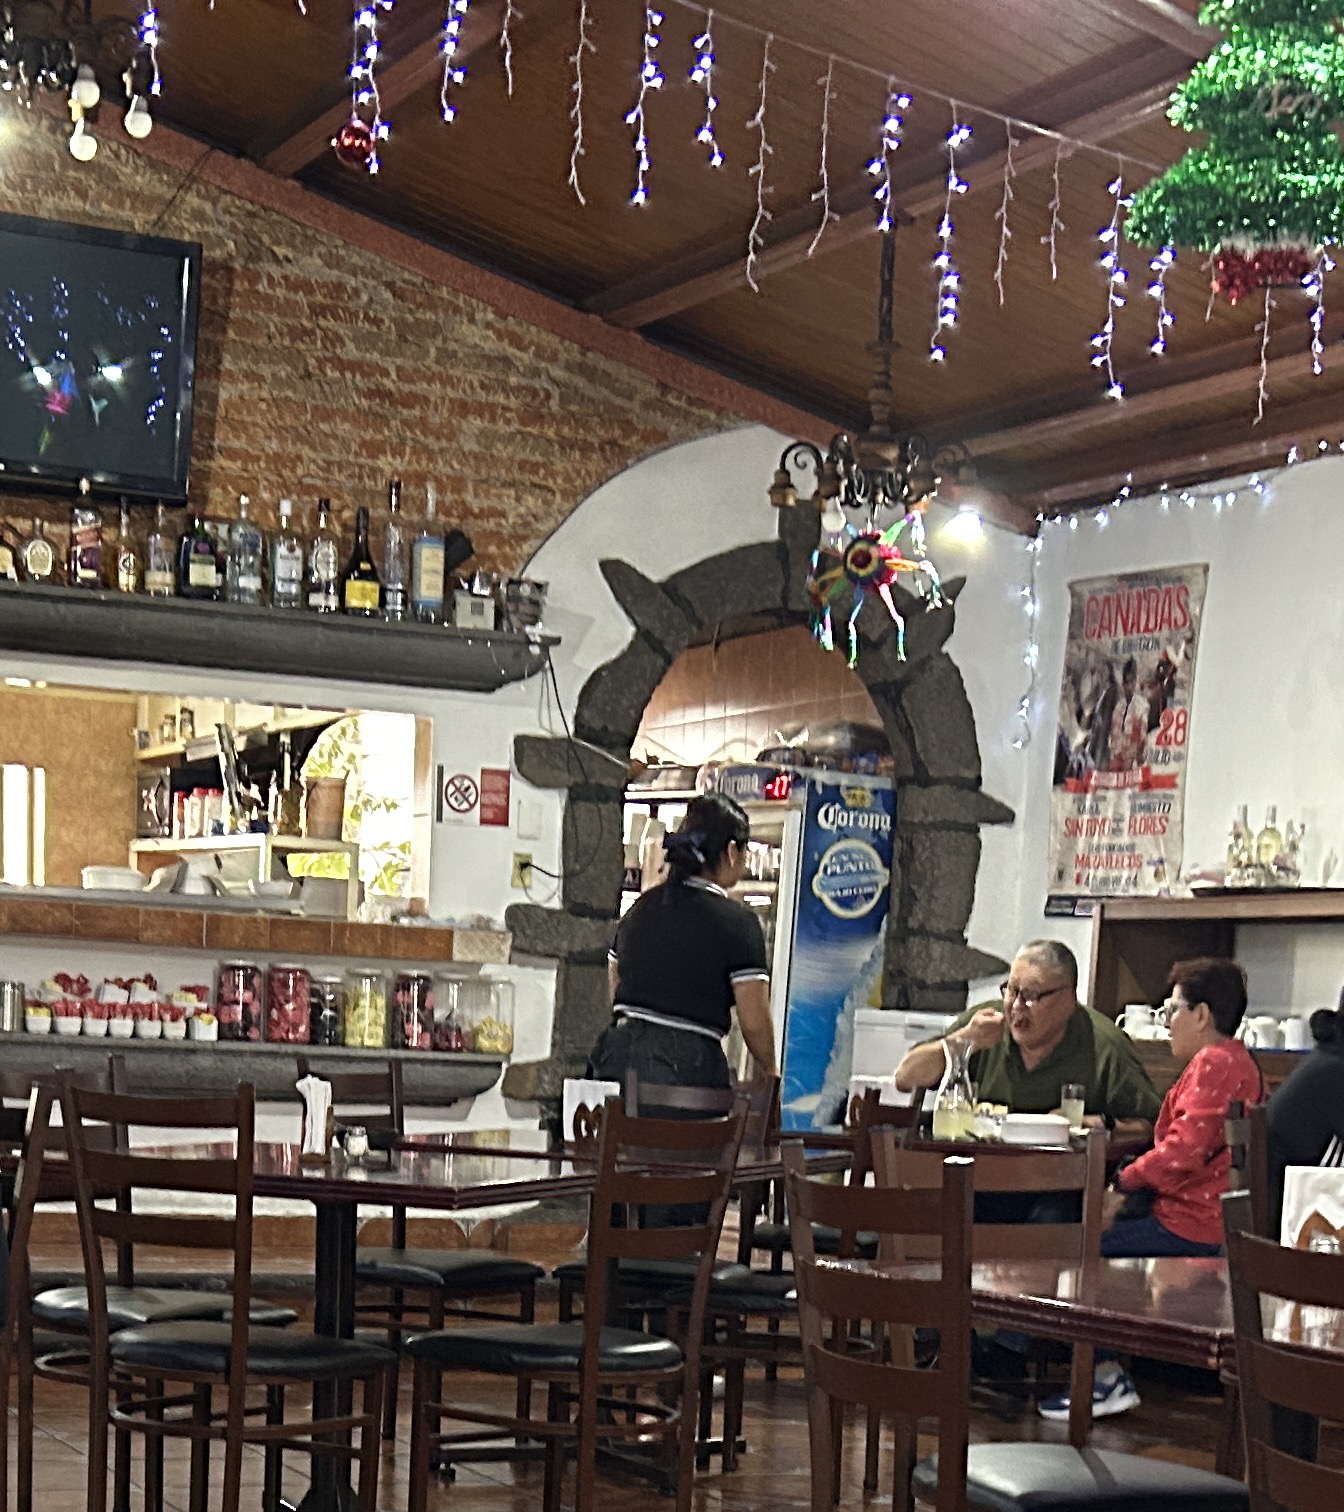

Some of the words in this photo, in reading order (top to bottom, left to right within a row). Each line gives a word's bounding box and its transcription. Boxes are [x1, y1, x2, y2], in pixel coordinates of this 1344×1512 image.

[1157, 708, 1188, 747] 28
[817, 802, 891, 834] Corona
[1128, 815, 1169, 836] FLORES
